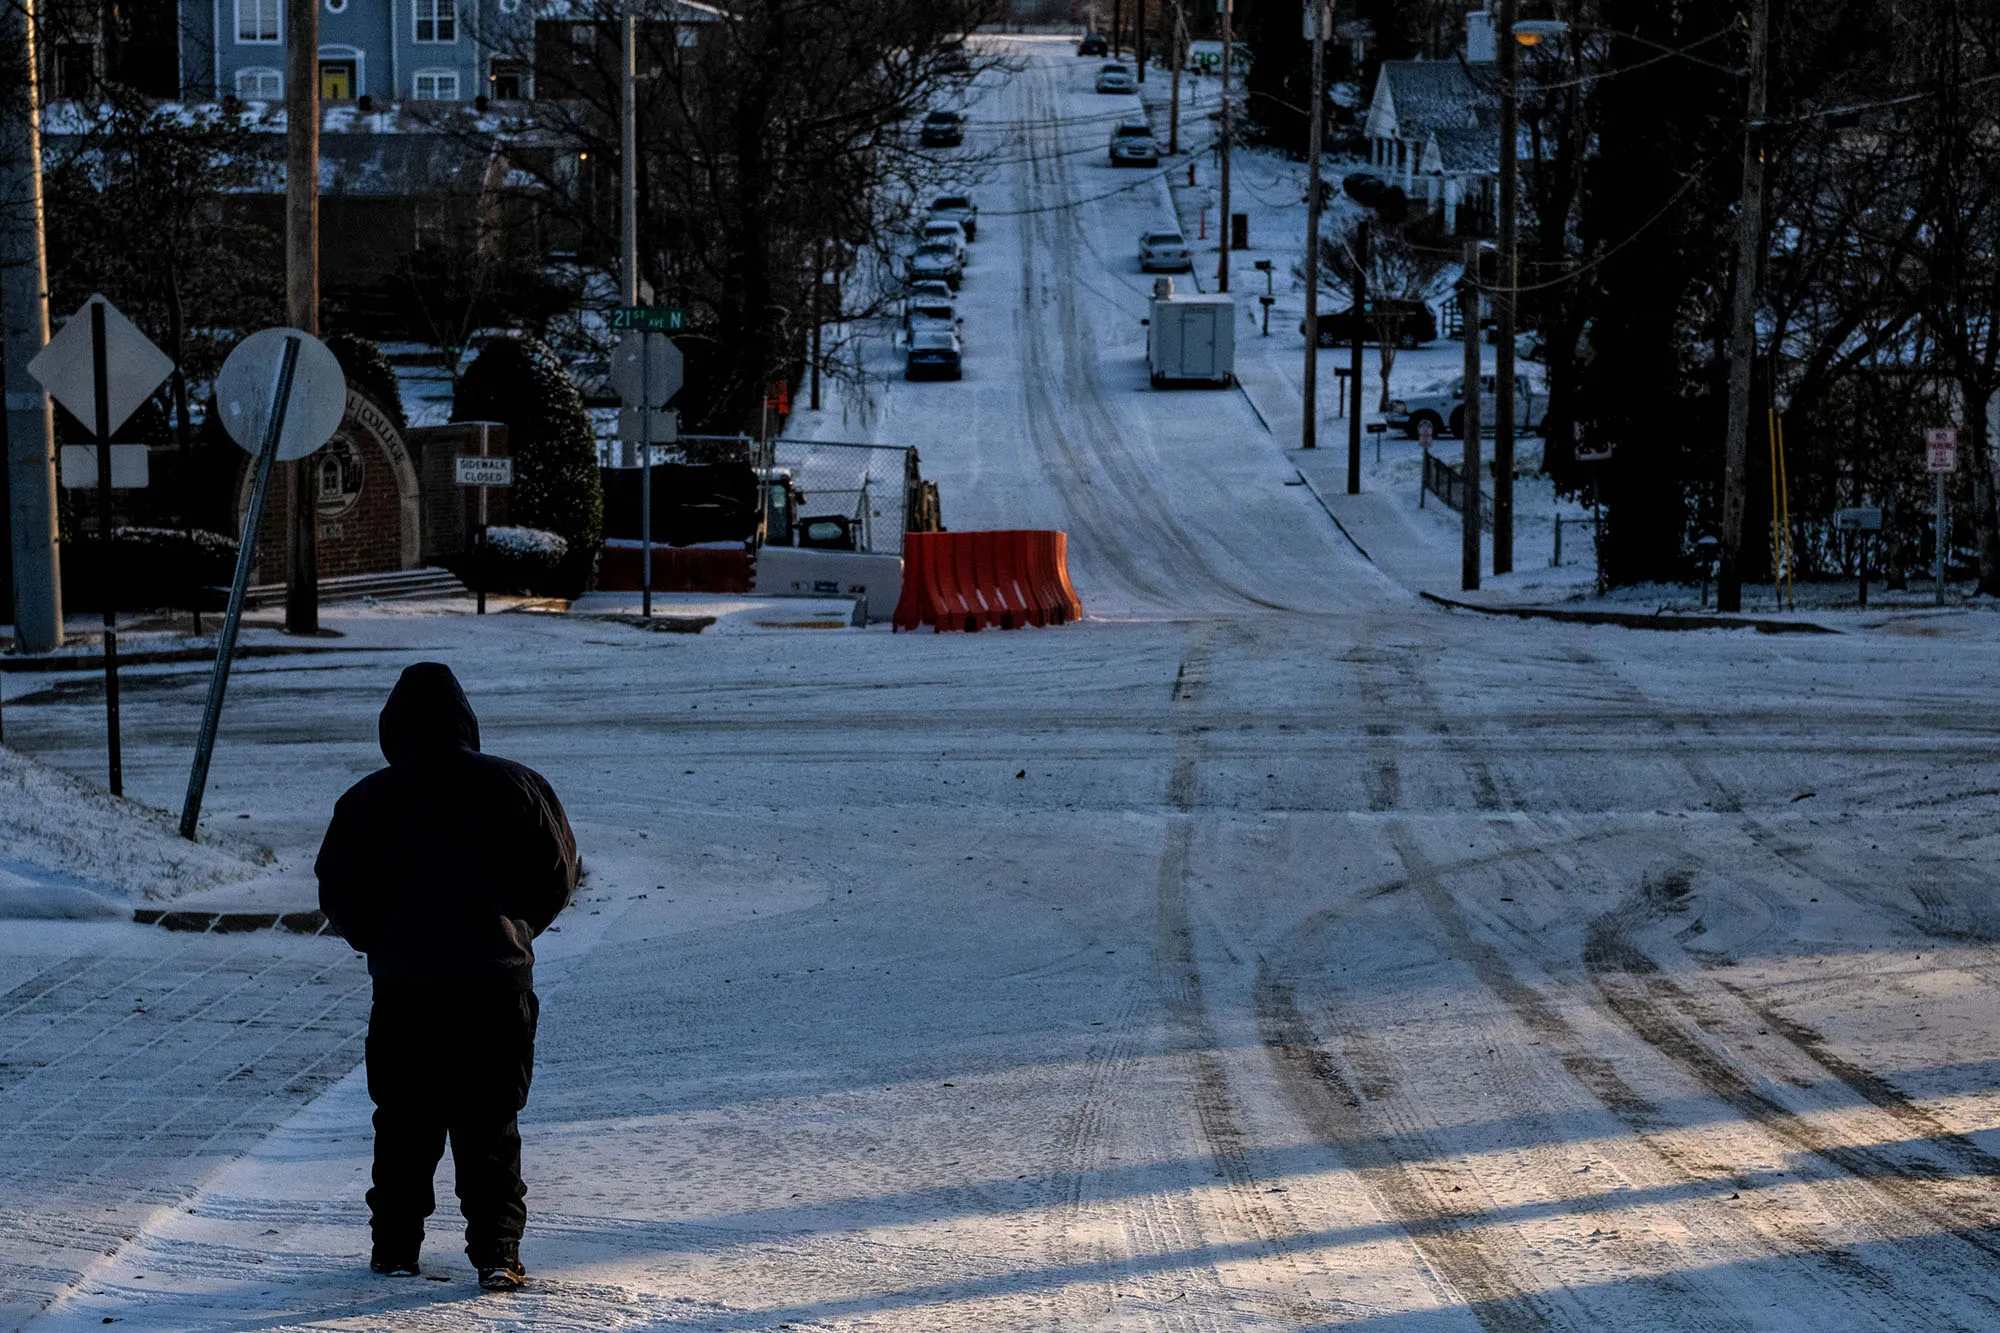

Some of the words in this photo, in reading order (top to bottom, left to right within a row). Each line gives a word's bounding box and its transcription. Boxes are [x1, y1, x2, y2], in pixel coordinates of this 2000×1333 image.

[669, 311, 682, 329] N
[362, 408, 405, 466] COLLEGE
[460, 459, 507, 470] SIDEWALK
[464, 471, 502, 482] CLOSED
